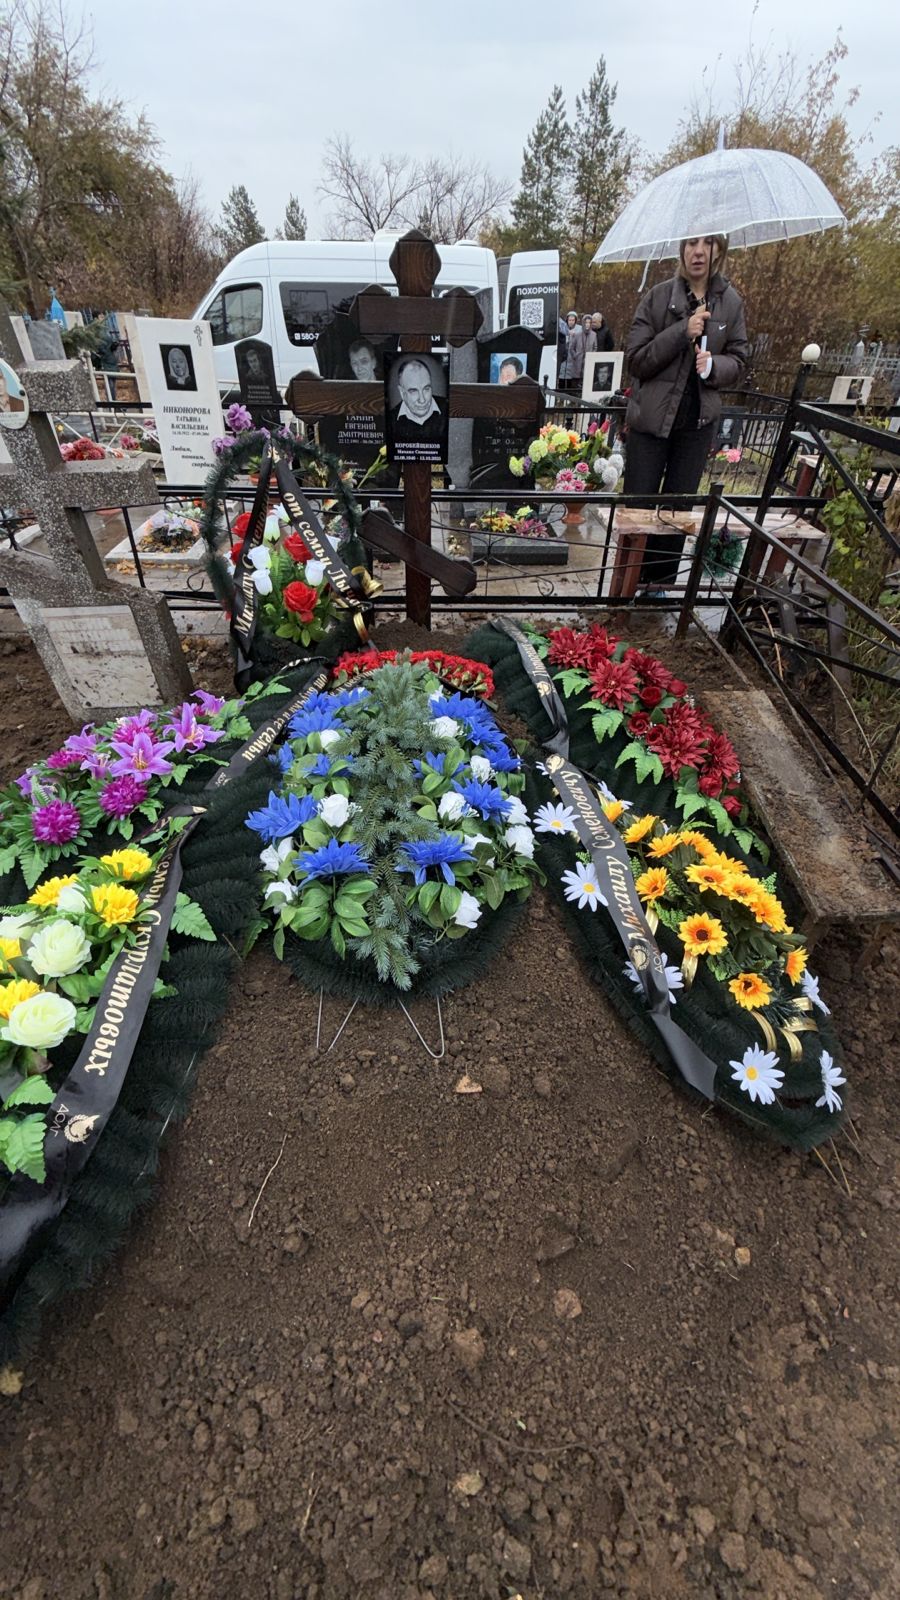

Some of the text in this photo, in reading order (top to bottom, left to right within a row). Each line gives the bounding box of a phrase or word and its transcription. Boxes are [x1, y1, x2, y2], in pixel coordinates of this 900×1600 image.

[337, 431, 384, 439] ДМИТРИЕВИЧ
[344, 422, 376, 430] ЕВГЕНИЙ
[283, 492, 303, 518] от
[298, 521, 333, 565] семьи
[241, 726, 277, 761] семьи
[560, 769, 650, 942] Михаилу Семеновичу
[83, 908, 163, 1077] Скурлатовых
